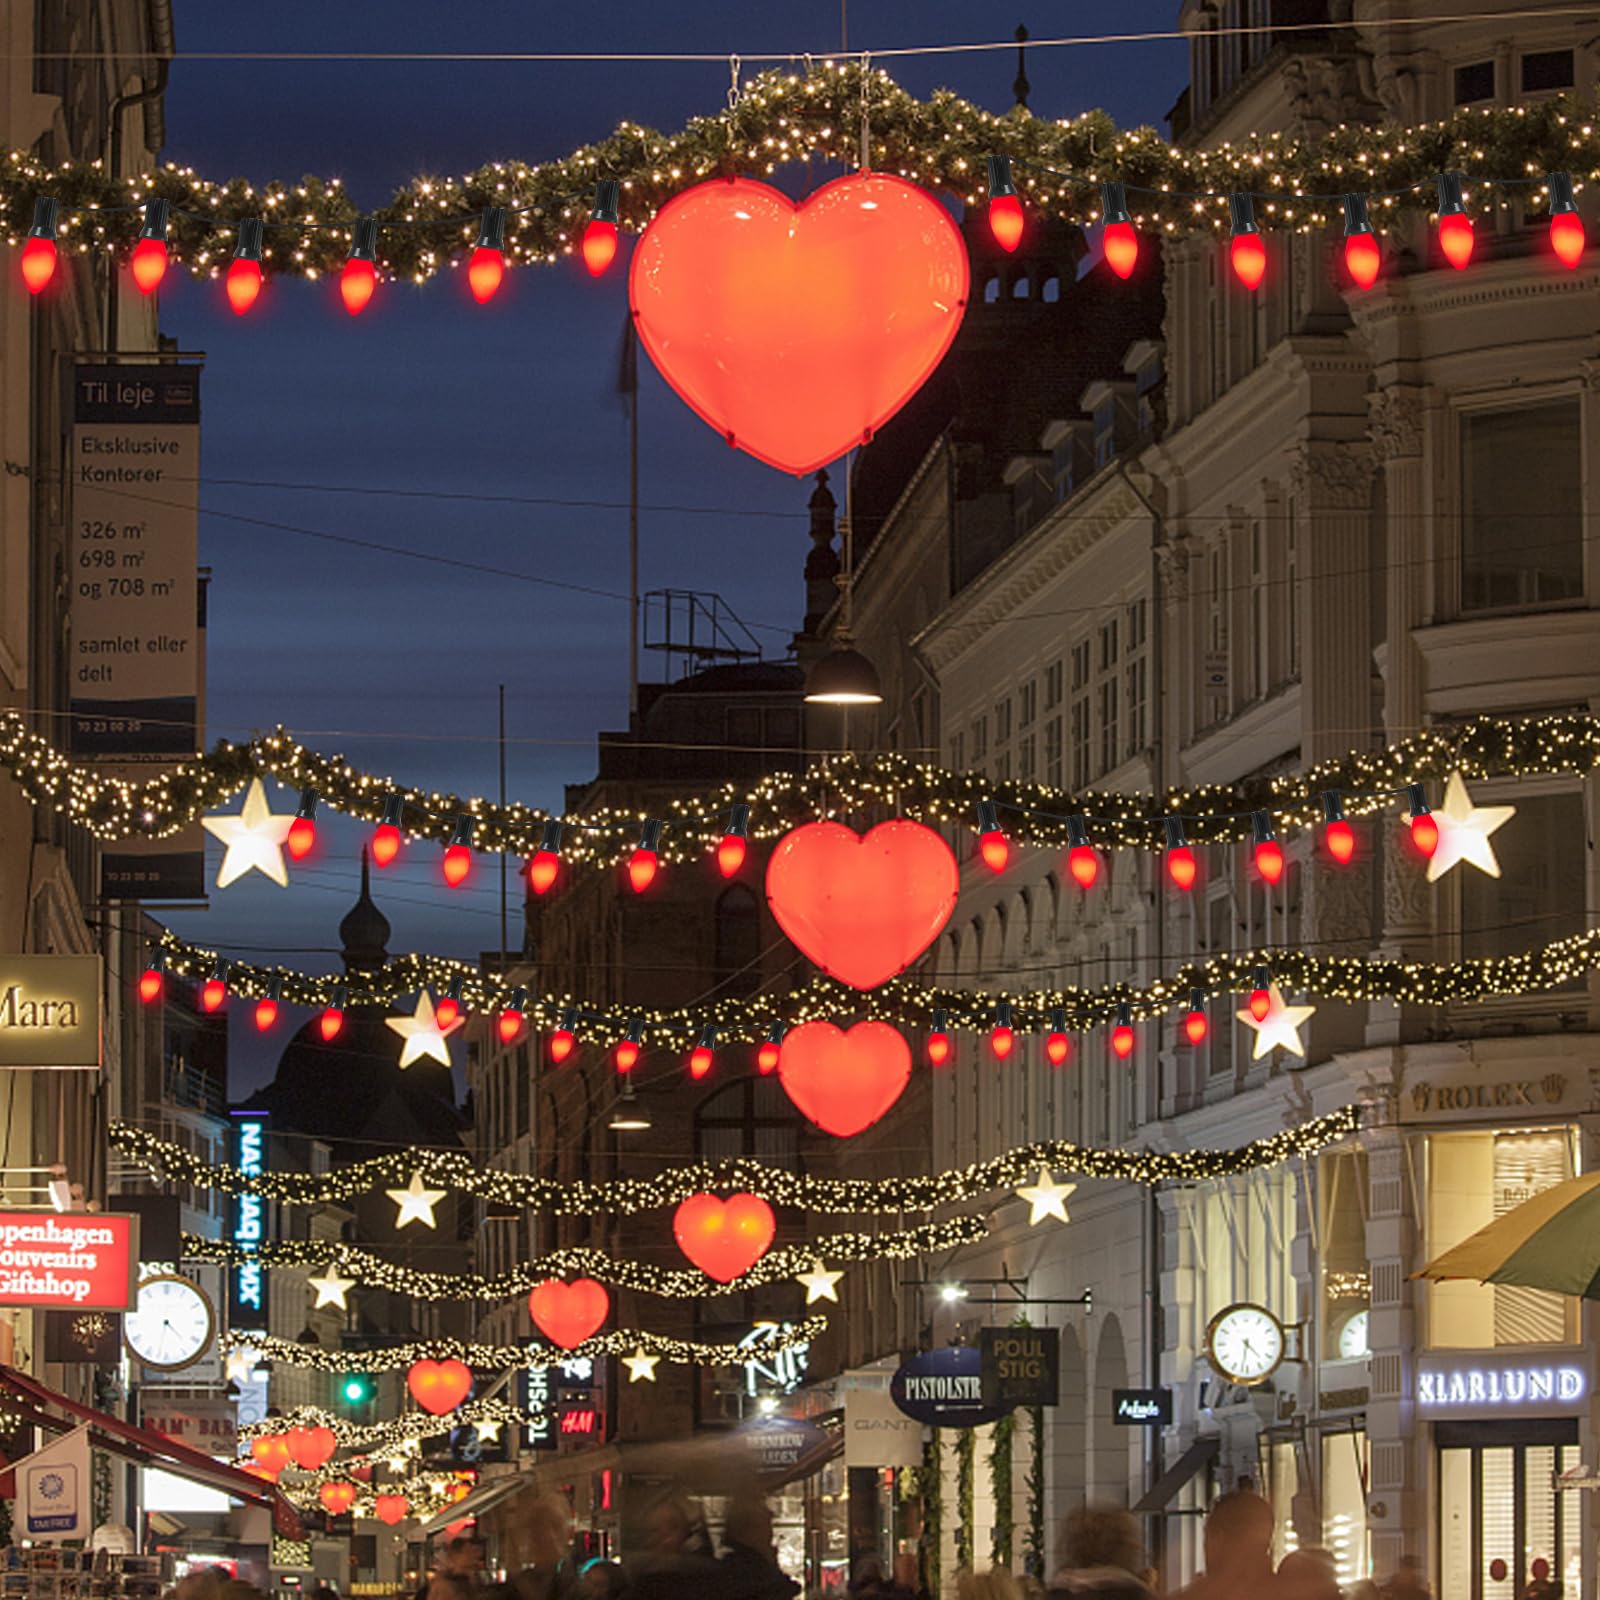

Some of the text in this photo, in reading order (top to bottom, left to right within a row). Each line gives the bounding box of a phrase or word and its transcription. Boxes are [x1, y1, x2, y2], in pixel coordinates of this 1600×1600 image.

[82, 381, 109, 404] Til
[117, 381, 155, 409] leje
[81, 437, 180, 455] Eksklusive
[80, 465, 164, 483] Kontorer
[80, 522, 117, 540] 326
[79, 551, 116, 568] 698
[79, 583, 102, 600] og
[108, 579, 145, 596] 708
[79, 637, 188, 654] samlet eller
[78, 663, 113, 682] delt
[1437, 1081, 1535, 1111] ROLEX
[993, 1339, 1046, 1359] POUL
[998, 1360, 1042, 1380] STIG
[1418, 1367, 1584, 1403] KLARLUND
[854, 1418, 912, 1432] GANT
